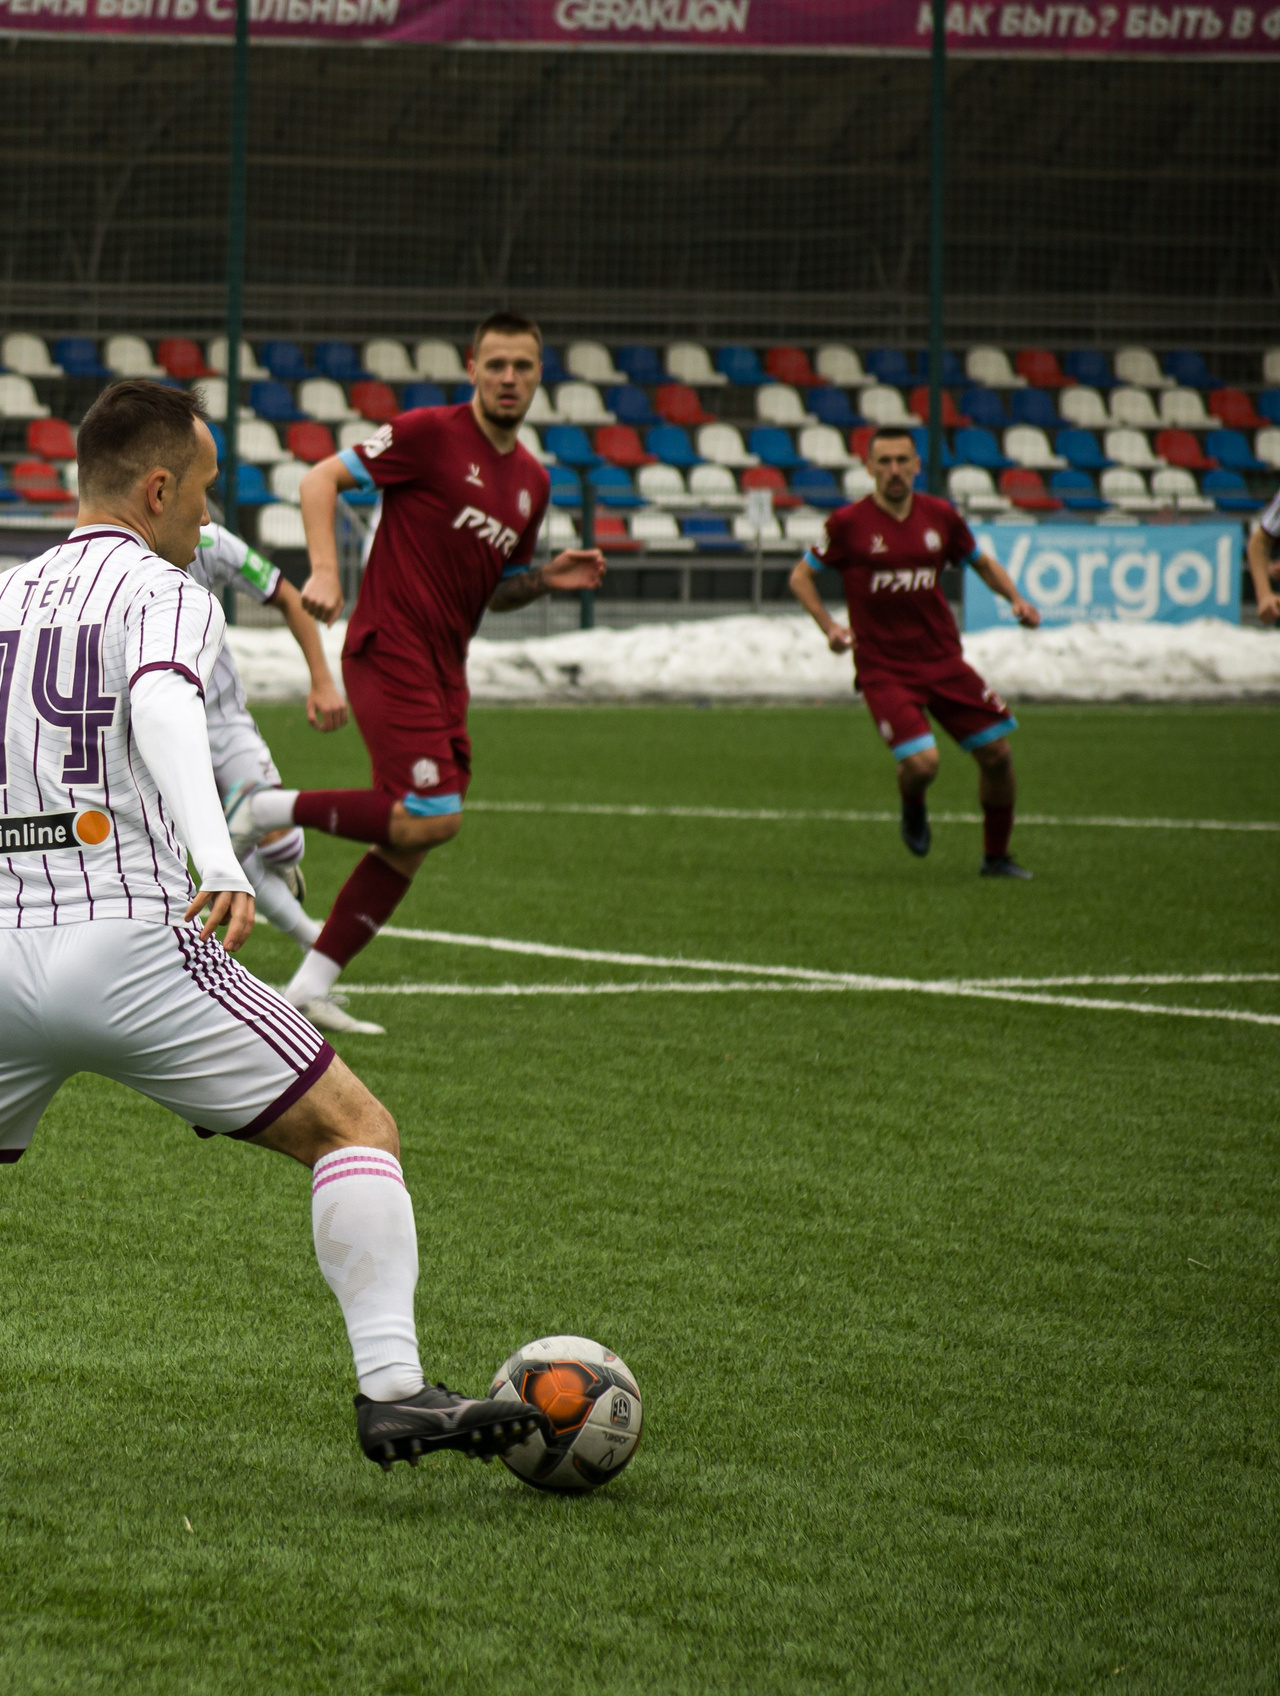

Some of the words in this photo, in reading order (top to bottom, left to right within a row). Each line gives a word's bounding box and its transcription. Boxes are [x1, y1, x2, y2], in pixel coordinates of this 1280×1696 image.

[999, 6, 1117, 38] БЫТЬ?
[1124, 7, 1221, 40] БЫТЬ
[1230, 7, 1255, 39] В
[978, 535, 1232, 620] Vorgol
